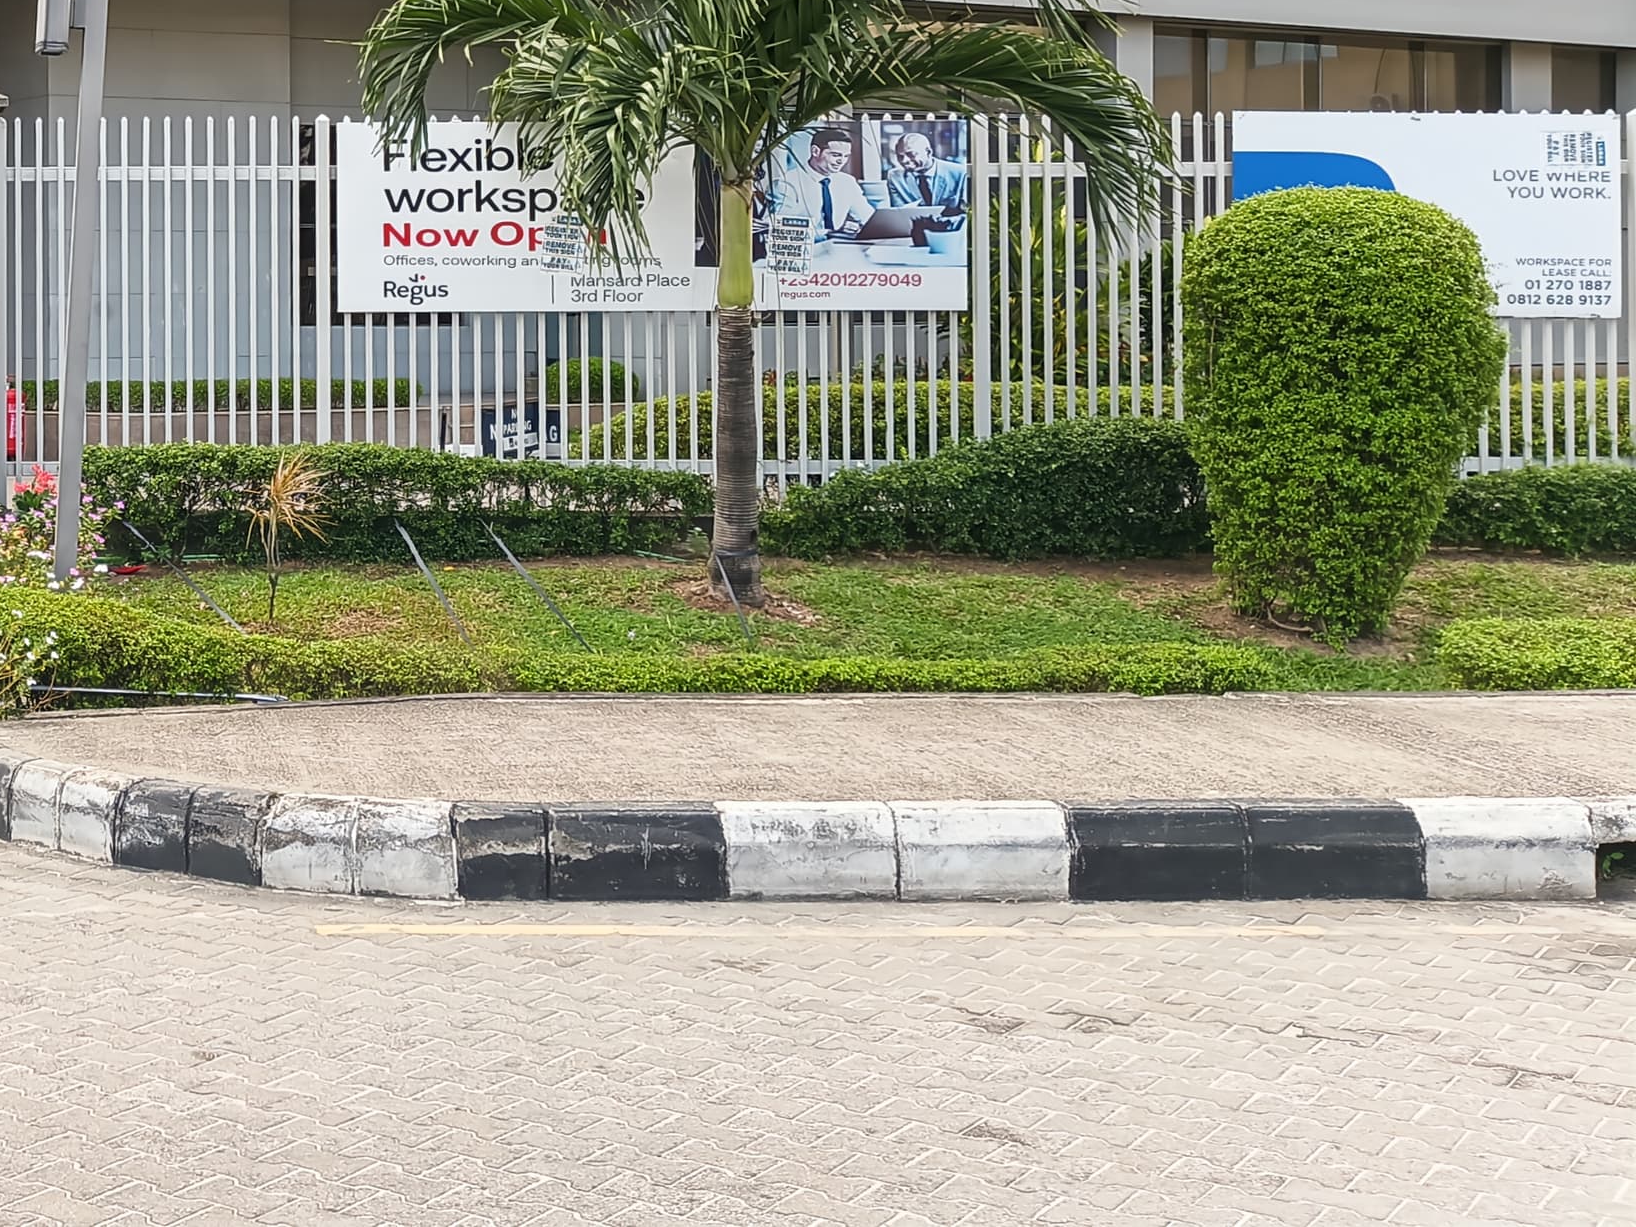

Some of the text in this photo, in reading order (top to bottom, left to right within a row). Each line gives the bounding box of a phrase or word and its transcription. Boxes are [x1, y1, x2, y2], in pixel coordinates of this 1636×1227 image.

[383, 138, 555, 172] Flexible
[1493, 170, 1611, 182] LOVE WHERE
[1507, 187, 1611, 199] YOU WORK.
[383, 221, 607, 251] Now Op
[545, 241, 576, 249] REMOVE
[383, 254, 539, 269] Offices, coworking an
[614, 256, 662, 267] ooms
[1516, 258, 1584, 266] WORKSPACE
[1542, 269, 1577, 277] LEASE
[571, 273, 691, 287] Mansard Place
[1524, 280, 1612, 291] 01 270 1887
[383, 280, 449, 306] Regus
[571, 289, 644, 302] 3rd Floor
[780, 291, 831, 299] regus.com
[1506, 294, 1612, 306] 0812 628 9137
